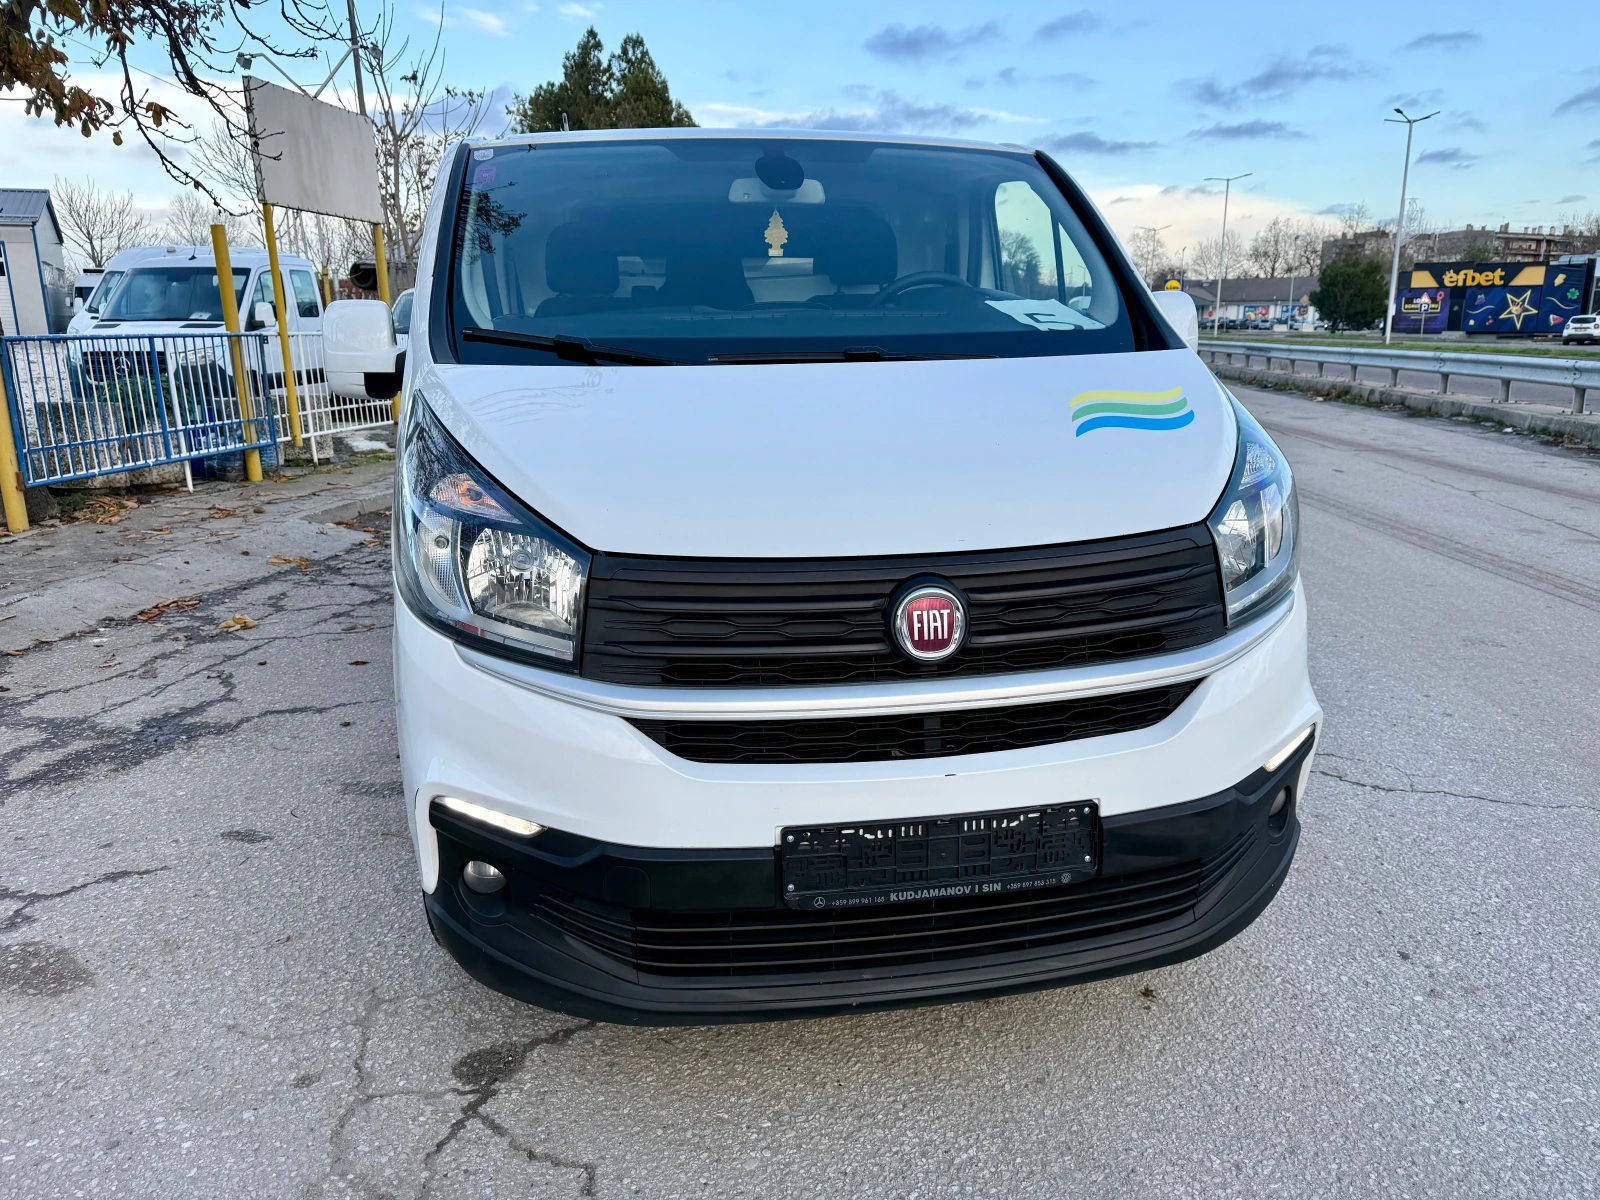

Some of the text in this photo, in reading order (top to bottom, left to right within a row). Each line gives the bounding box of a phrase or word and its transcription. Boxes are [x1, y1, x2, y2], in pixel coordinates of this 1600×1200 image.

[1442, 268, 1505, 287] efbet
[913, 609, 950, 641] FIAT
[890, 885, 971, 902] KUDJAMANOV
[975, 885, 979, 893] I
[982, 883, 1002, 892] SIN
